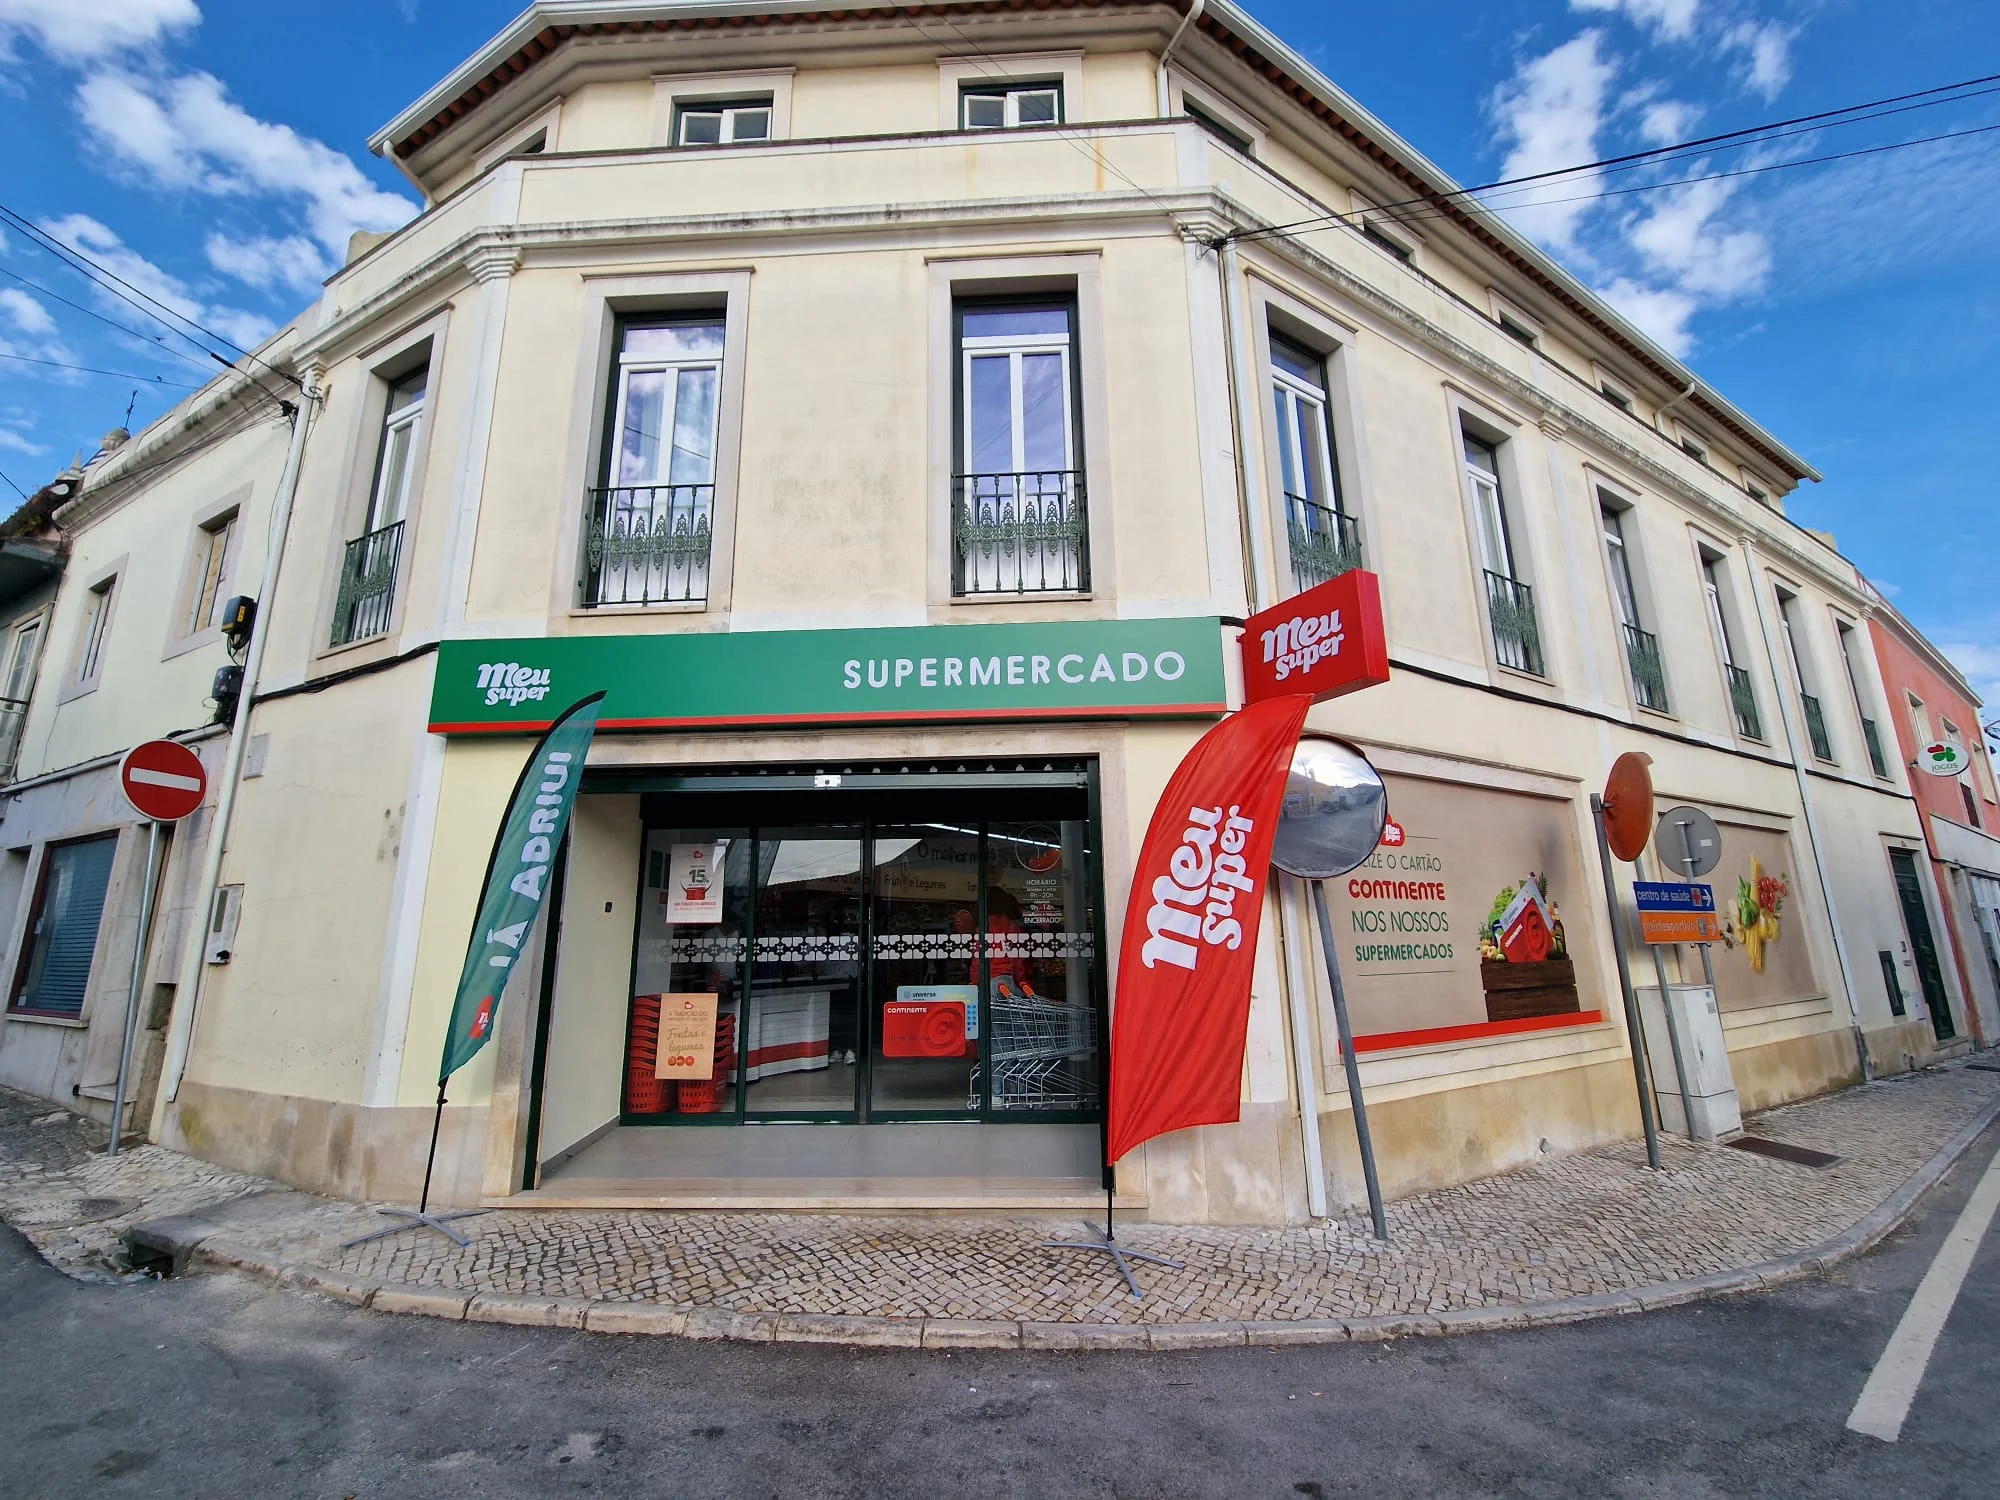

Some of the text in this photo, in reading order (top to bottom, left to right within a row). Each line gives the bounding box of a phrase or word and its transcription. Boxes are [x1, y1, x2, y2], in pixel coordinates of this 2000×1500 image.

[1275, 633, 1345, 681] super
[843, 651, 1186, 689] SUPERMERCADO
[484, 686, 550, 707] super
[1386, 854, 1397, 869] O
[1400, 853, 1442, 872] CARTÃO
[1026, 877, 1057, 886] HORÁRIO
[1202, 804, 1254, 951] super
[1348, 878, 1446, 901] CONTINENTE
[1637, 889, 1691, 902] centro de saúde
[1024, 916, 1061, 925] ENCERRADO
[1352, 910, 1449, 933] NOS NOSSOS
[1355, 943, 1454, 962] SUPERMERCADOS
